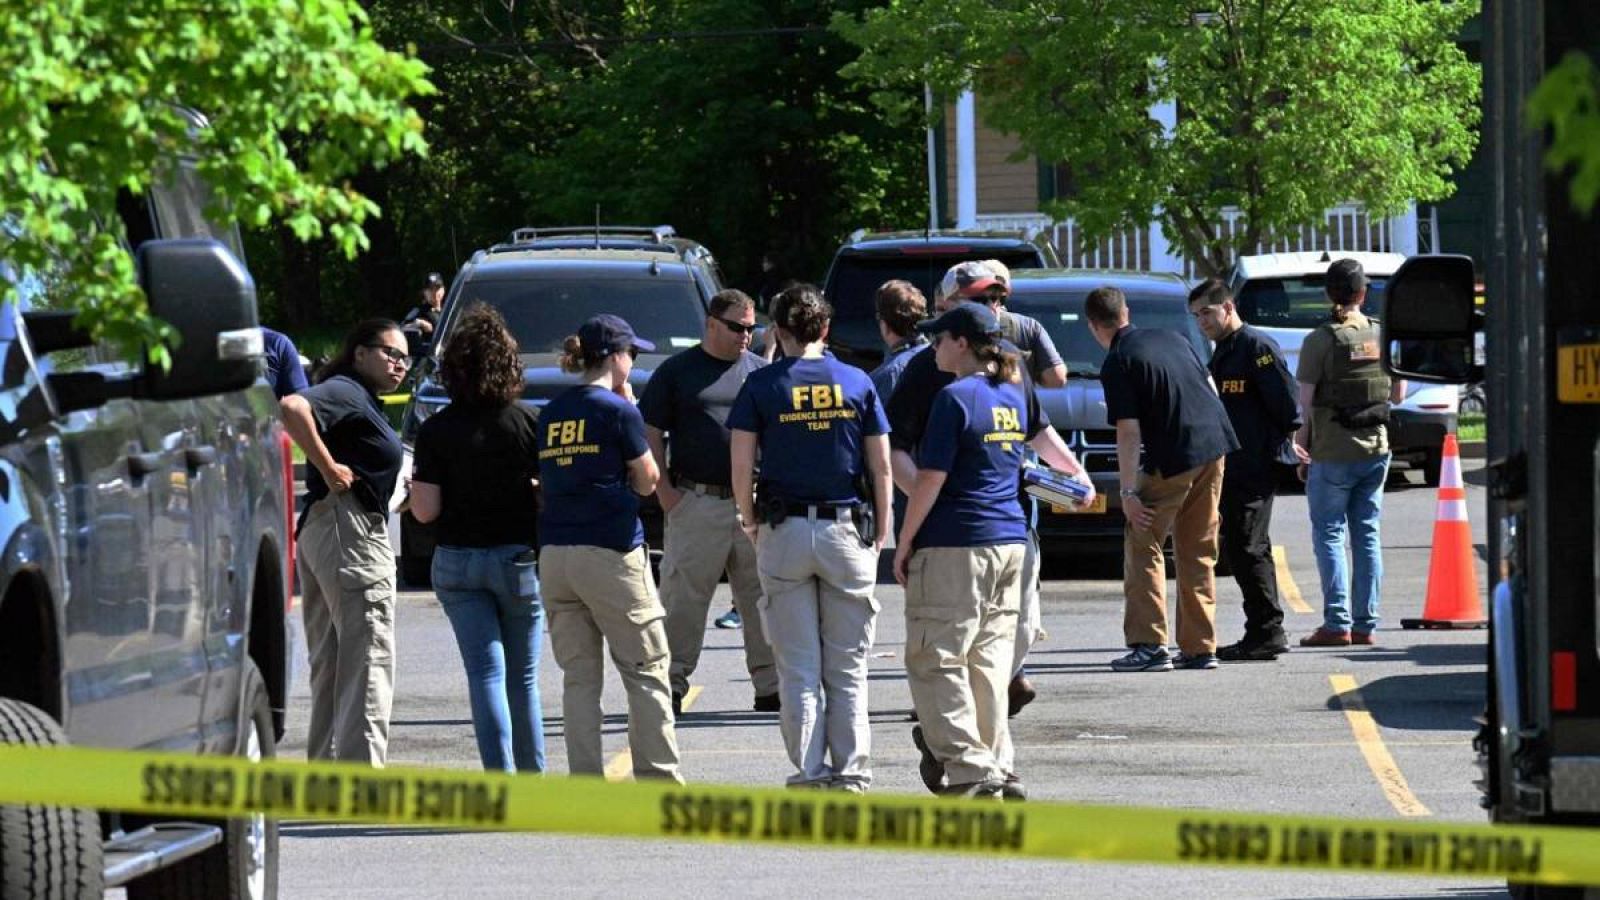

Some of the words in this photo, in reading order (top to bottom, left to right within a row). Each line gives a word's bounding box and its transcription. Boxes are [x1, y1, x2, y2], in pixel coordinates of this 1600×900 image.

[792, 384, 843, 410] FBI
[1222, 380, 1246, 393] FBI
[547, 419, 585, 447] FBI
[780, 411, 817, 422] EVIDENCE
[807, 420, 831, 431] TEAM
[992, 406, 1020, 430] FBI
[564, 443, 600, 455] RESPONSE
[143, 761, 236, 806] CROSS
[246, 767, 295, 810] NOT
[303, 772, 342, 814] DO
[352, 776, 405, 818] LINE
[414, 778, 508, 822] POLICE
[659, 792, 752, 837] CROSS
[761, 798, 813, 839] NOT
[821, 801, 860, 841] DO
[869, 805, 924, 845] LINE
[932, 807, 1025, 849] POLICE
[1178, 819, 1271, 863] CROSS
[1280, 825, 1332, 865] NOT
[1339, 827, 1378, 868] DO
[1384, 830, 1439, 871] LINE
[1449, 832, 1542, 875] POLICE
